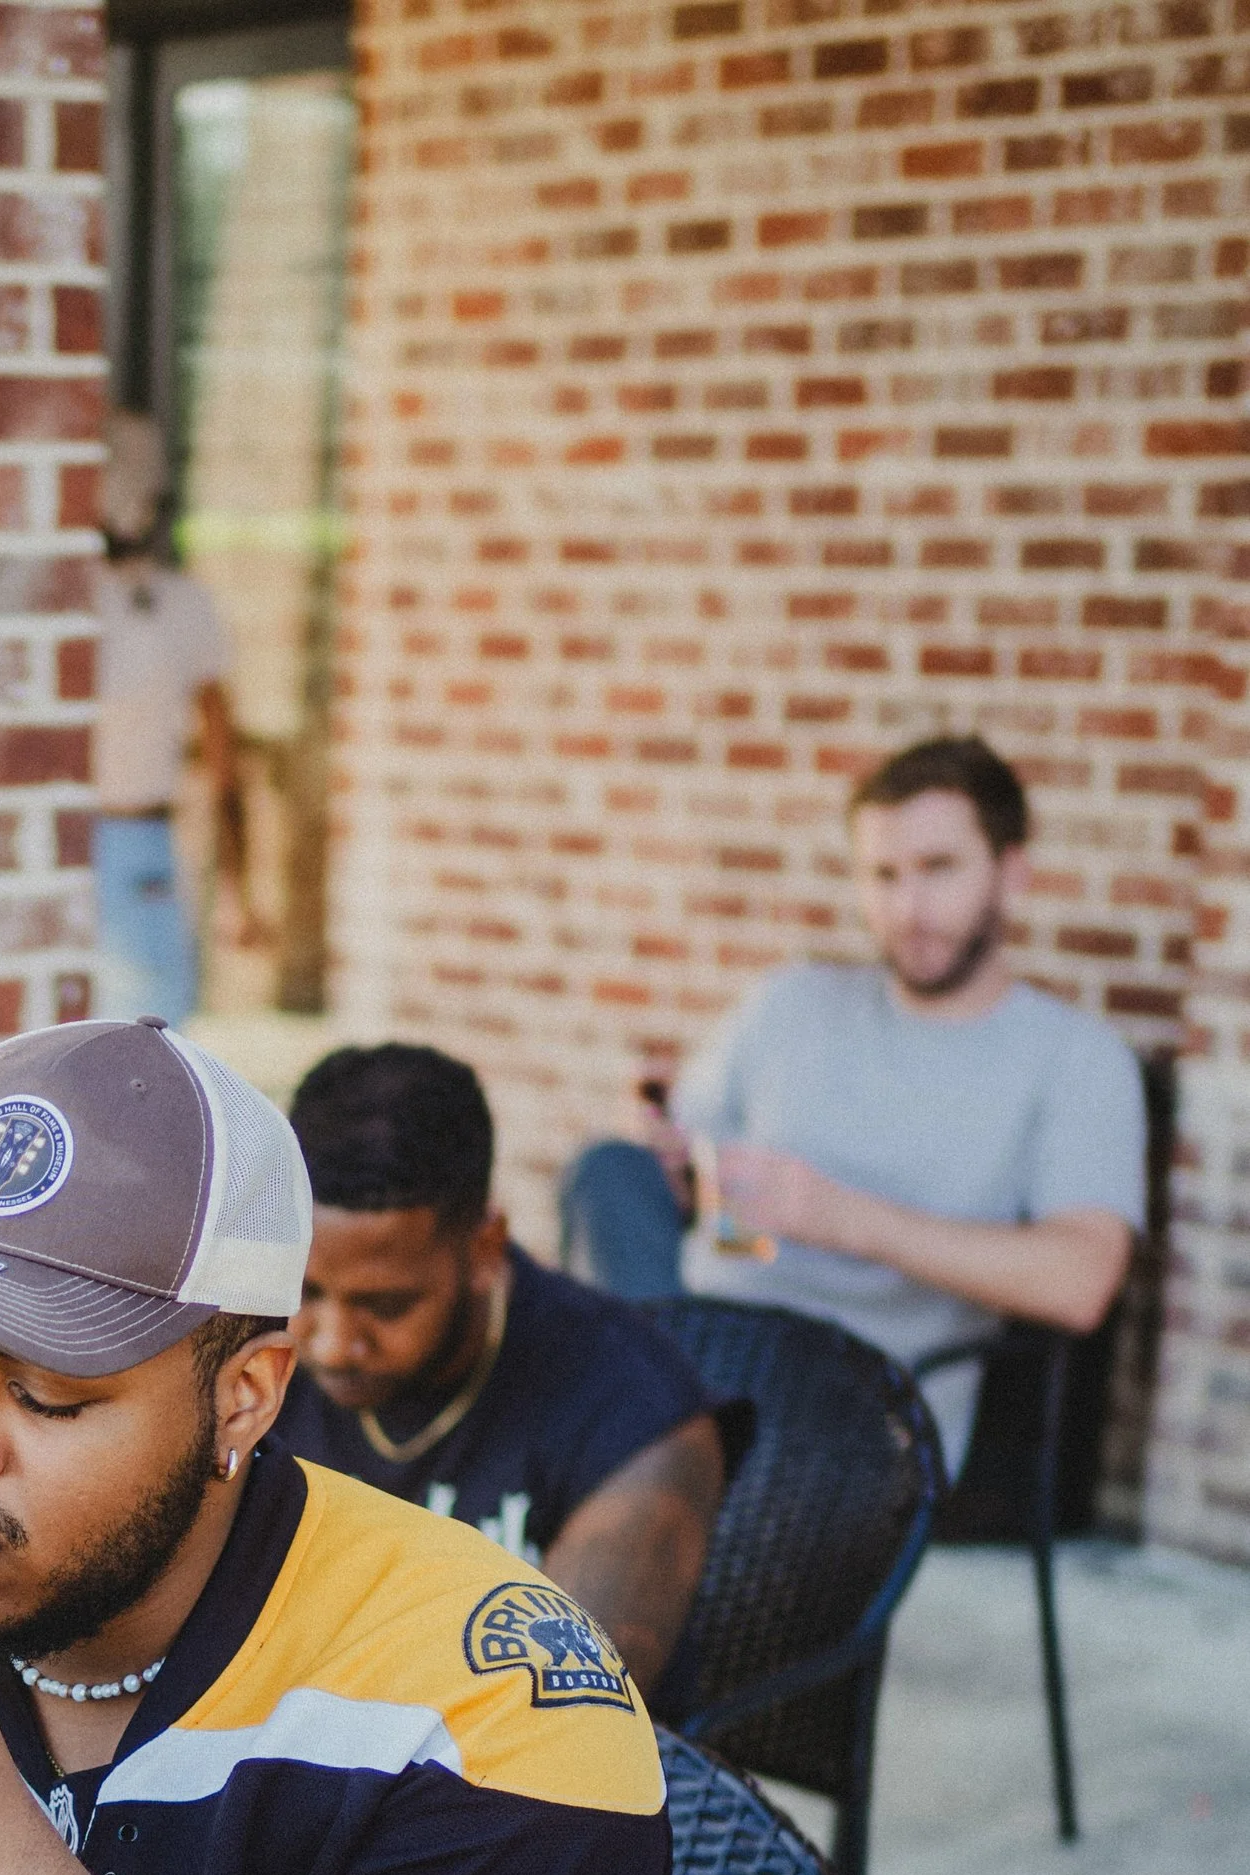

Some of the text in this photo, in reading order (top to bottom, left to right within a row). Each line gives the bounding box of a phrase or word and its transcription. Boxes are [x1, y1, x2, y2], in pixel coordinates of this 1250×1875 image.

[4, 1103, 28, 1113] HALL
[29, 1105, 42, 1115] OF
[47, 1141, 64, 1181] MUSEUM
[551, 1674, 619, 1691] BOSTON
